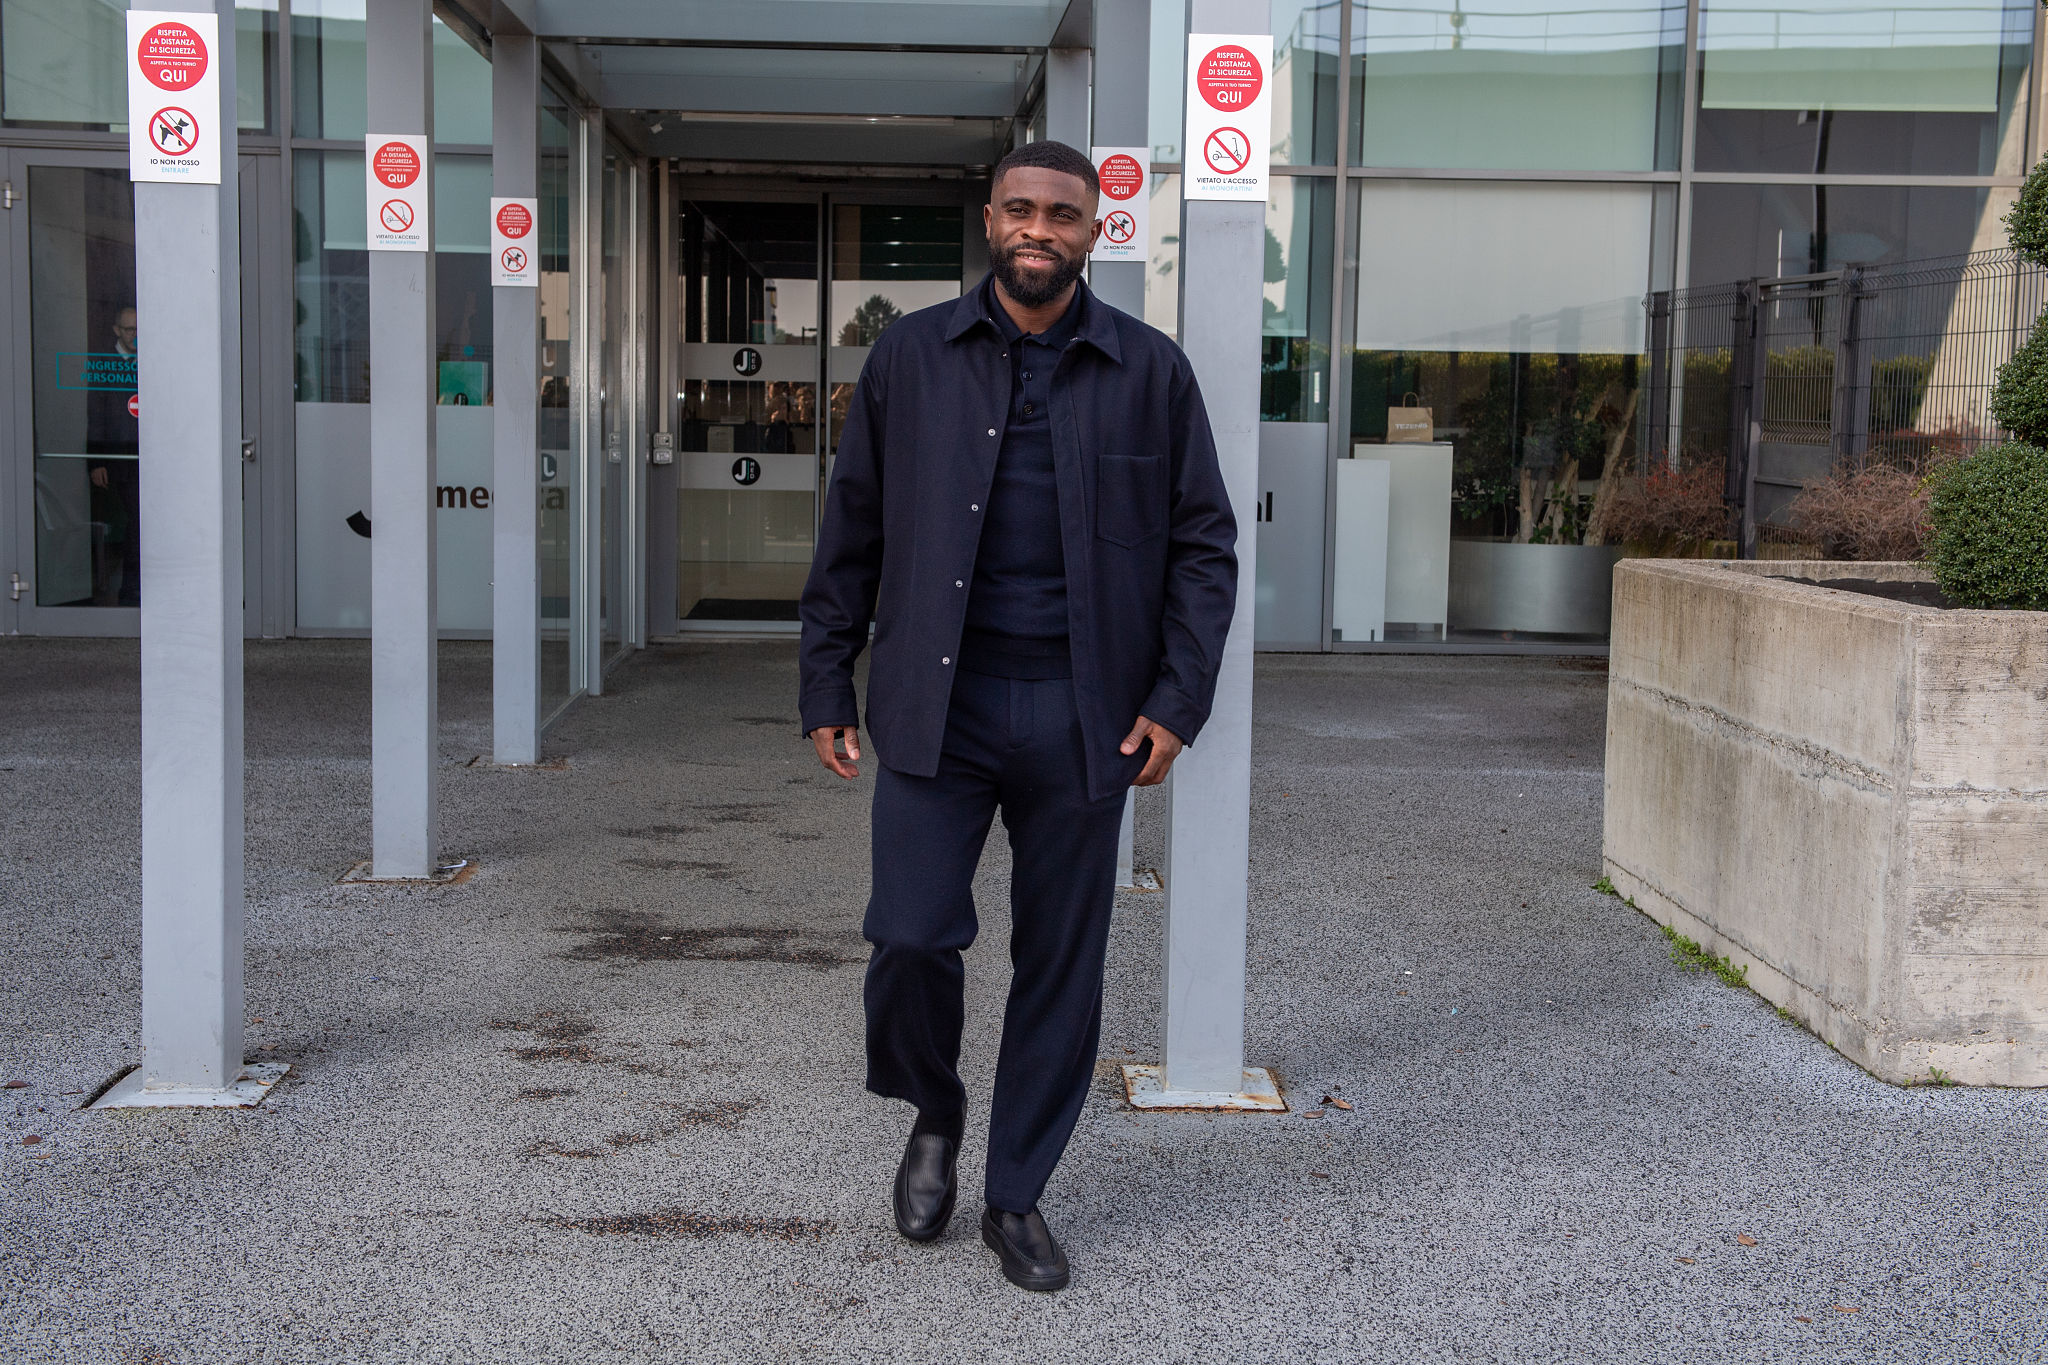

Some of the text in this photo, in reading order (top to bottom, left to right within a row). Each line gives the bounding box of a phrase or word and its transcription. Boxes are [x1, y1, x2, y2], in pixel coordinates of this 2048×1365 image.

[160, 69, 187, 82] QUI
[1217, 90, 1242, 104] QUI
[388, 174, 406, 183] QUI
[1112, 185, 1130, 195] QUI
[84, 360, 137, 371] INGRESSO
[736, 351, 748, 371] J
[735, 460, 746, 480] J
